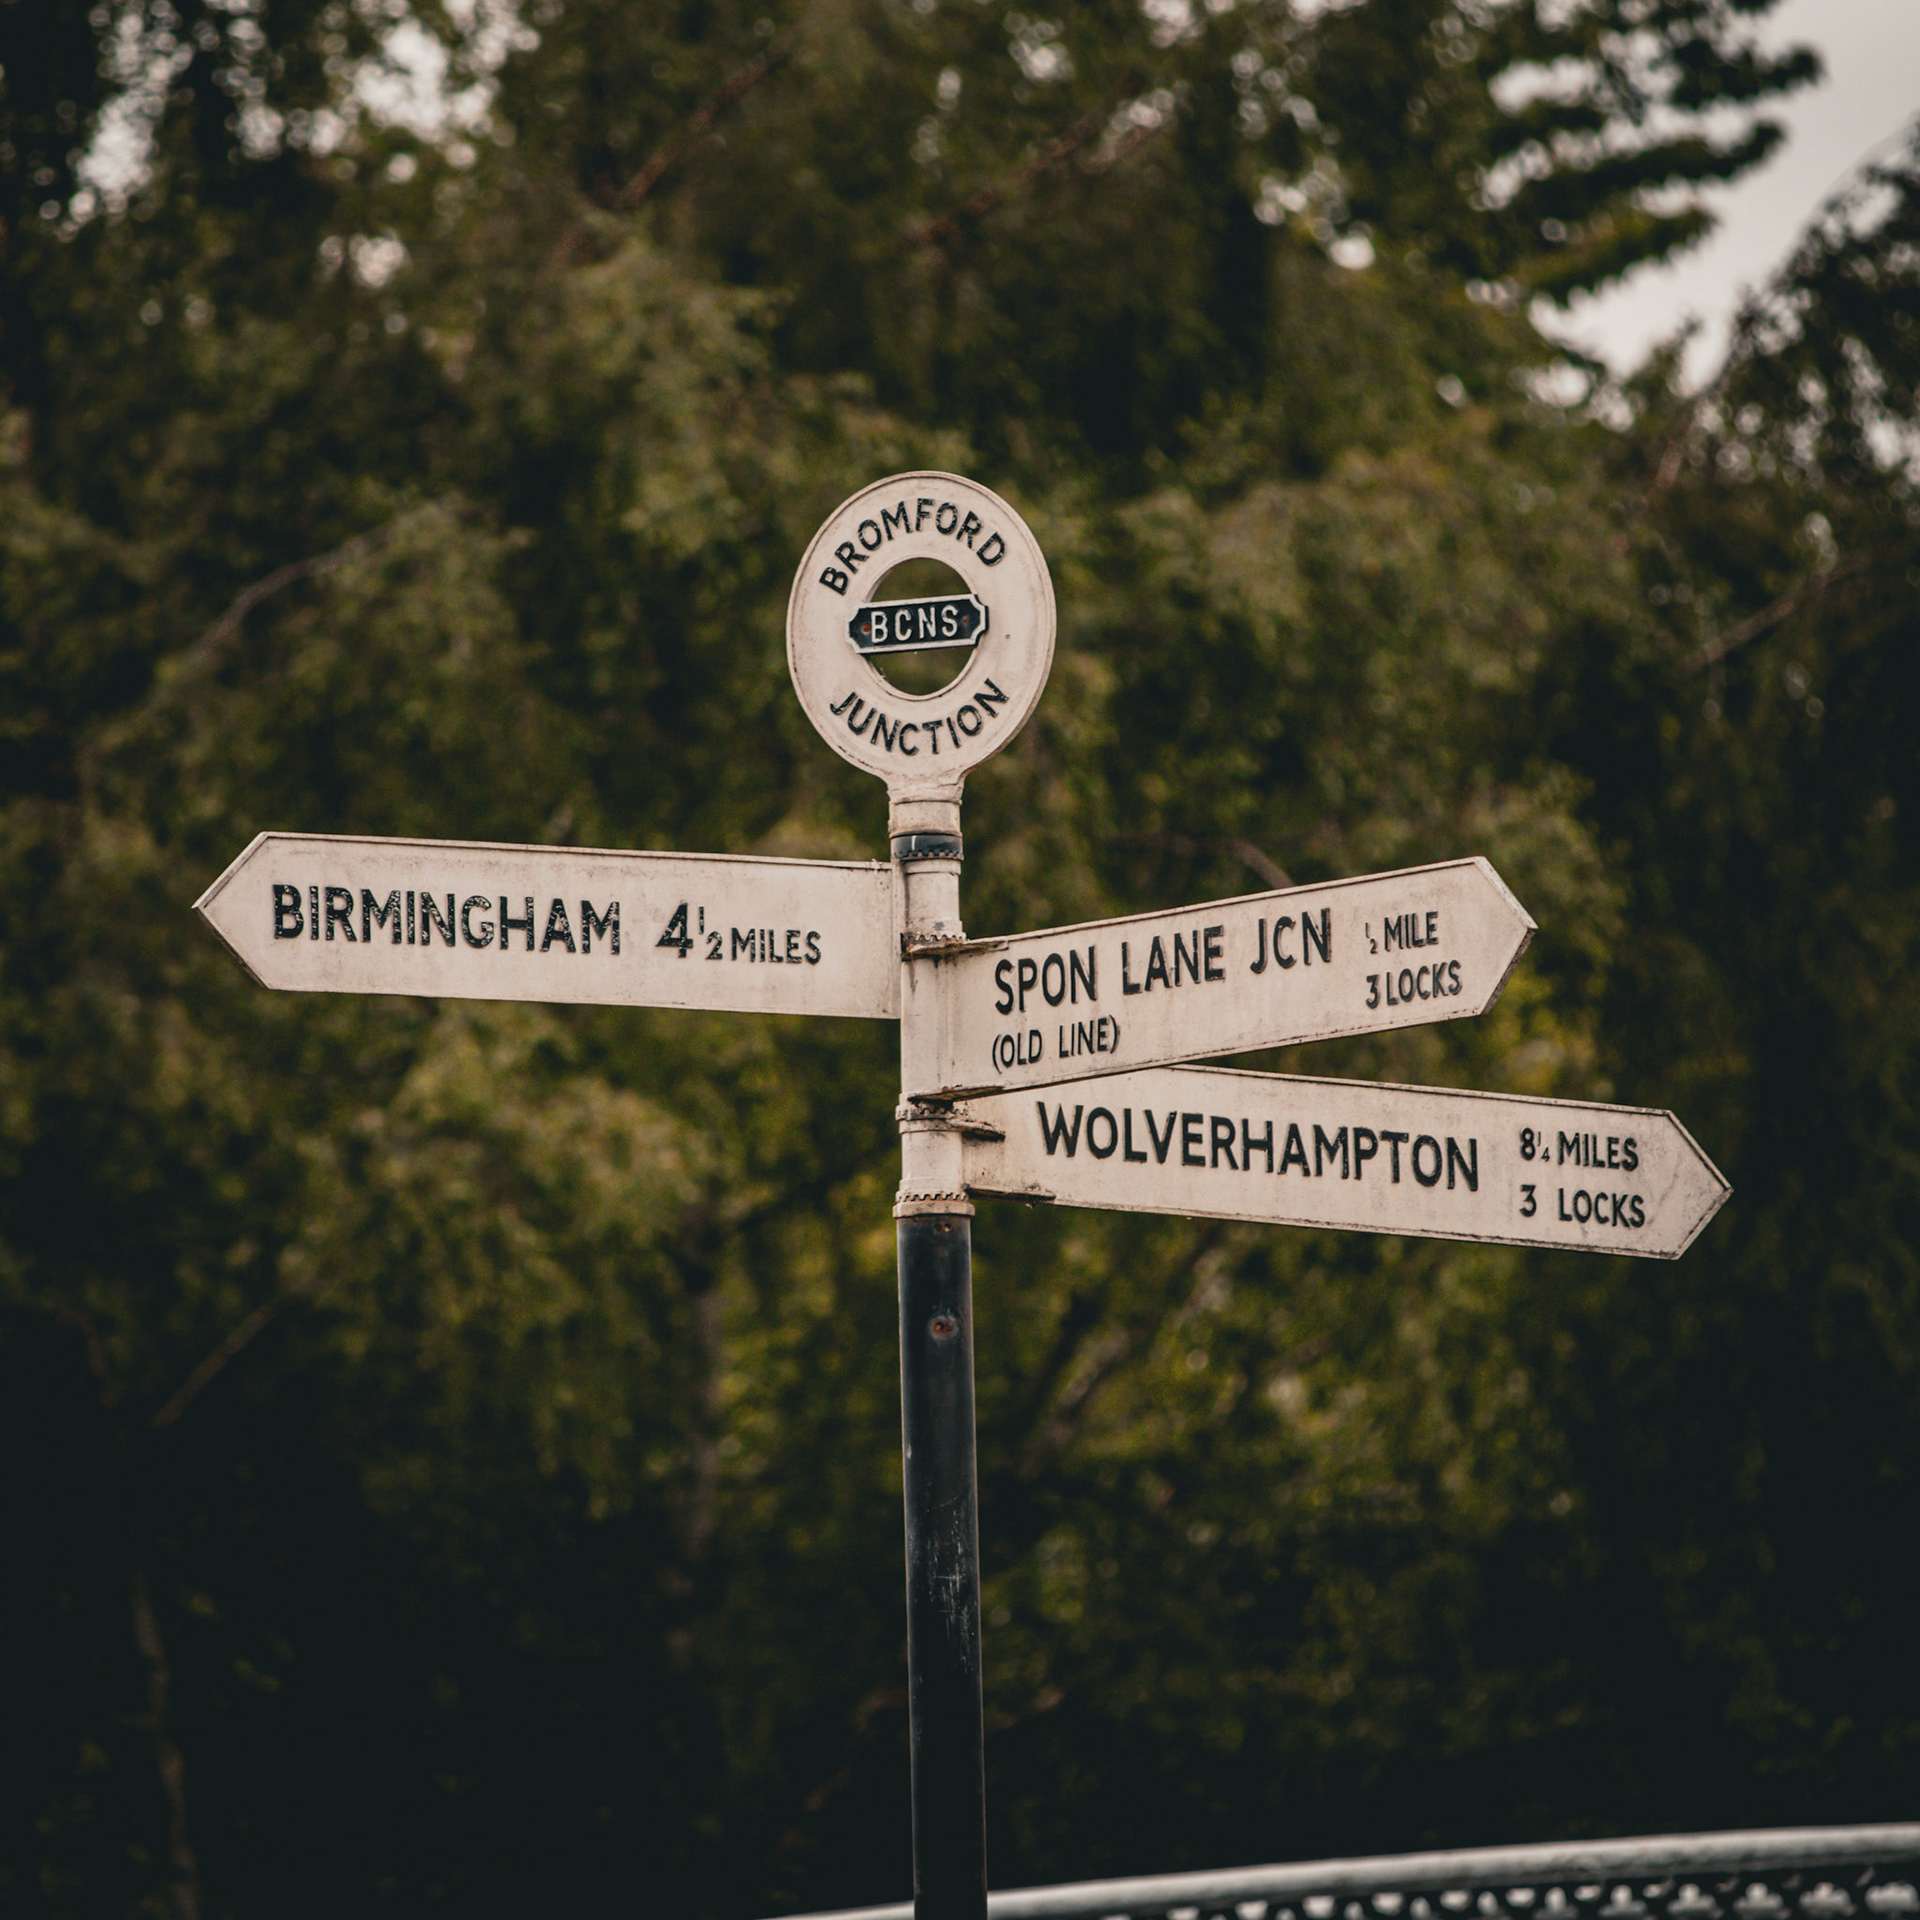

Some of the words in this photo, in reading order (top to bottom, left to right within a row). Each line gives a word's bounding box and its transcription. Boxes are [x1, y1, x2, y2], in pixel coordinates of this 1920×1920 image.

[819, 498, 1006, 595] BROMFORD
[870, 605, 959, 644] BCNS
[830, 678, 1010, 756] JUNCTION
[273, 884, 621, 956] BIRMINGHAM
[731, 927, 822, 966] MILES
[1384, 911, 1439, 952] MILE
[995, 945, 1098, 1015] SPON
[1122, 925, 1225, 996] LANE
[1249, 907, 1332, 976] JCN
[1366, 974, 1380, 1010] 3
[1386, 959, 1463, 1006] LOCKS
[991, 1029, 1043, 1074] (OLD
[1058, 1014, 1121, 1059] LINE)
[1037, 1100, 1479, 1192] WOLVERHAMPTON
[1558, 1131, 1640, 1172] MILES
[1519, 1184, 1537, 1218] 3
[1558, 1187, 1646, 1229] LOCKS
